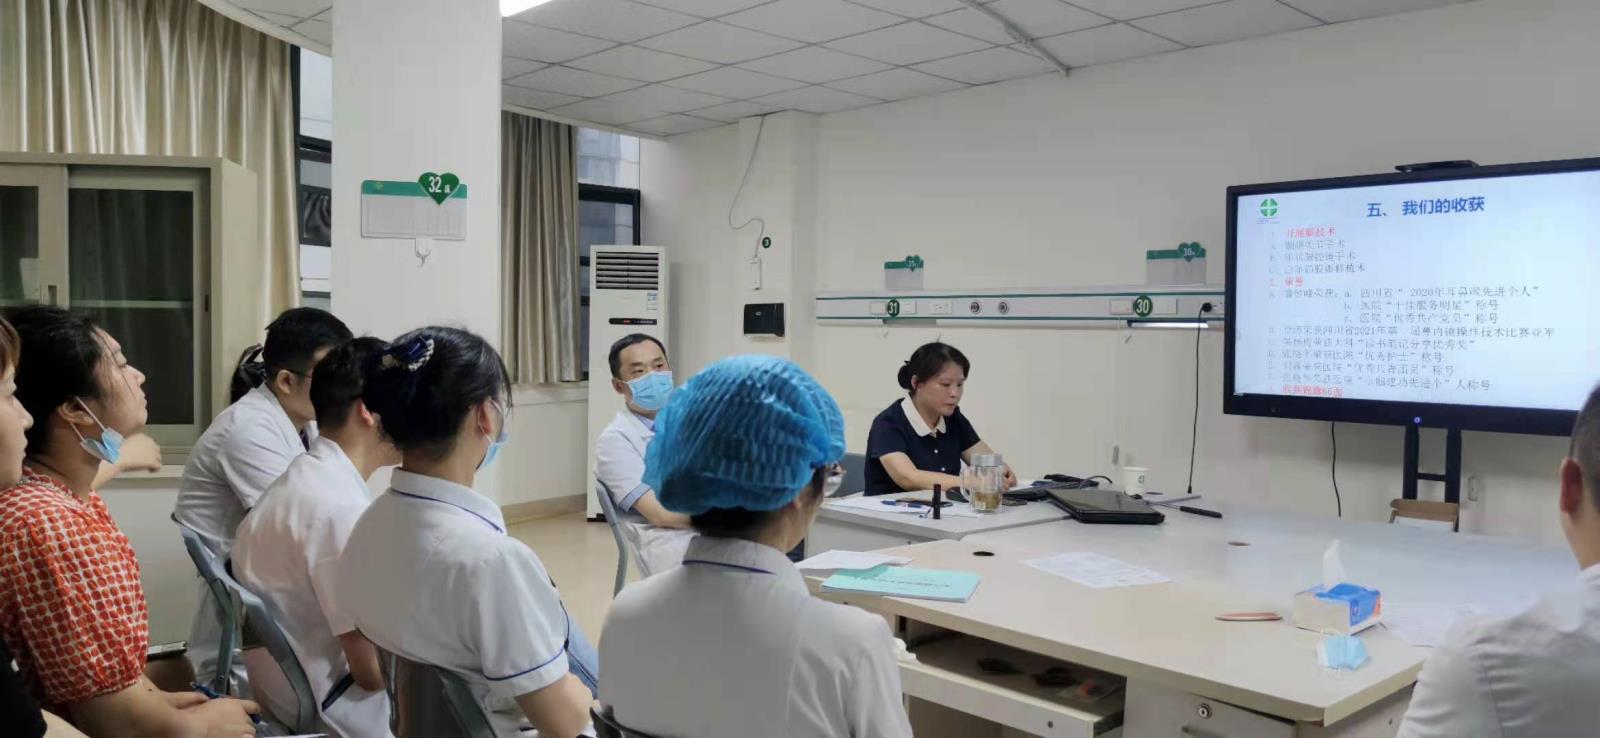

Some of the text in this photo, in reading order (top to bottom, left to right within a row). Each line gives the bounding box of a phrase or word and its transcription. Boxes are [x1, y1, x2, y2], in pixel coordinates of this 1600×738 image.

[428, 176, 442, 193] 32
[1402, 196, 1485, 216] 我们的收获
[1183, 247, 1192, 256] 30
[888, 301, 897, 314] 31
[1136, 299, 1149, 314] 30
